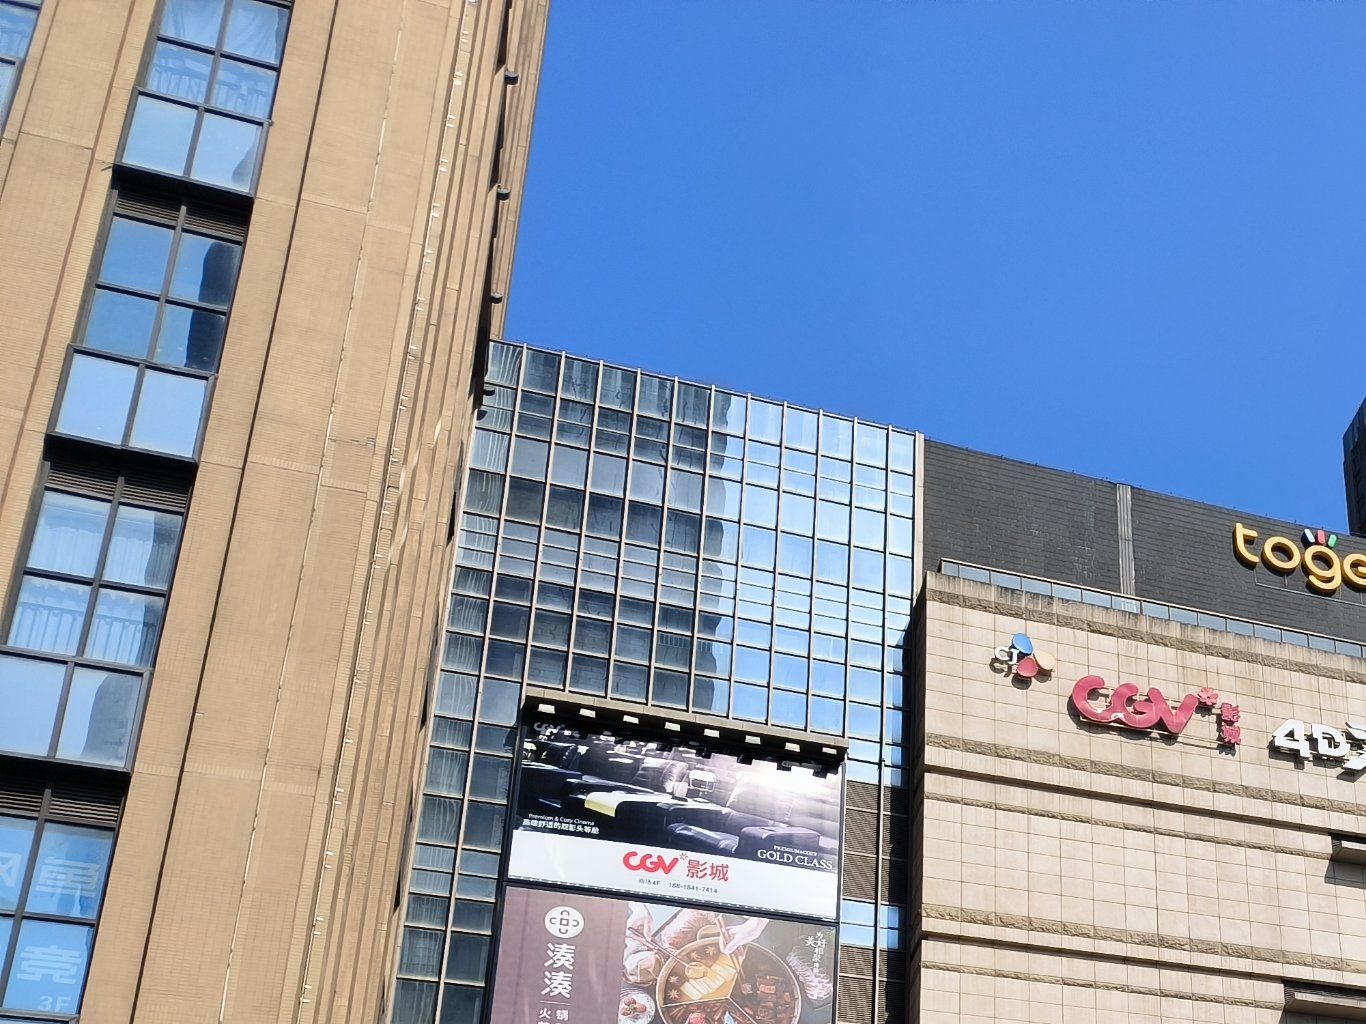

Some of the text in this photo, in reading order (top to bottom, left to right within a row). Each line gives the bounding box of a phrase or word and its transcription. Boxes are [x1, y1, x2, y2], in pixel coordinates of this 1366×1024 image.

[1072, 675, 1198, 733] CGV
[623, 851, 729, 882] CGV 影城
[757, 849, 833, 870] GOLD CLASS
[38, 995, 71, 1012] 3F
